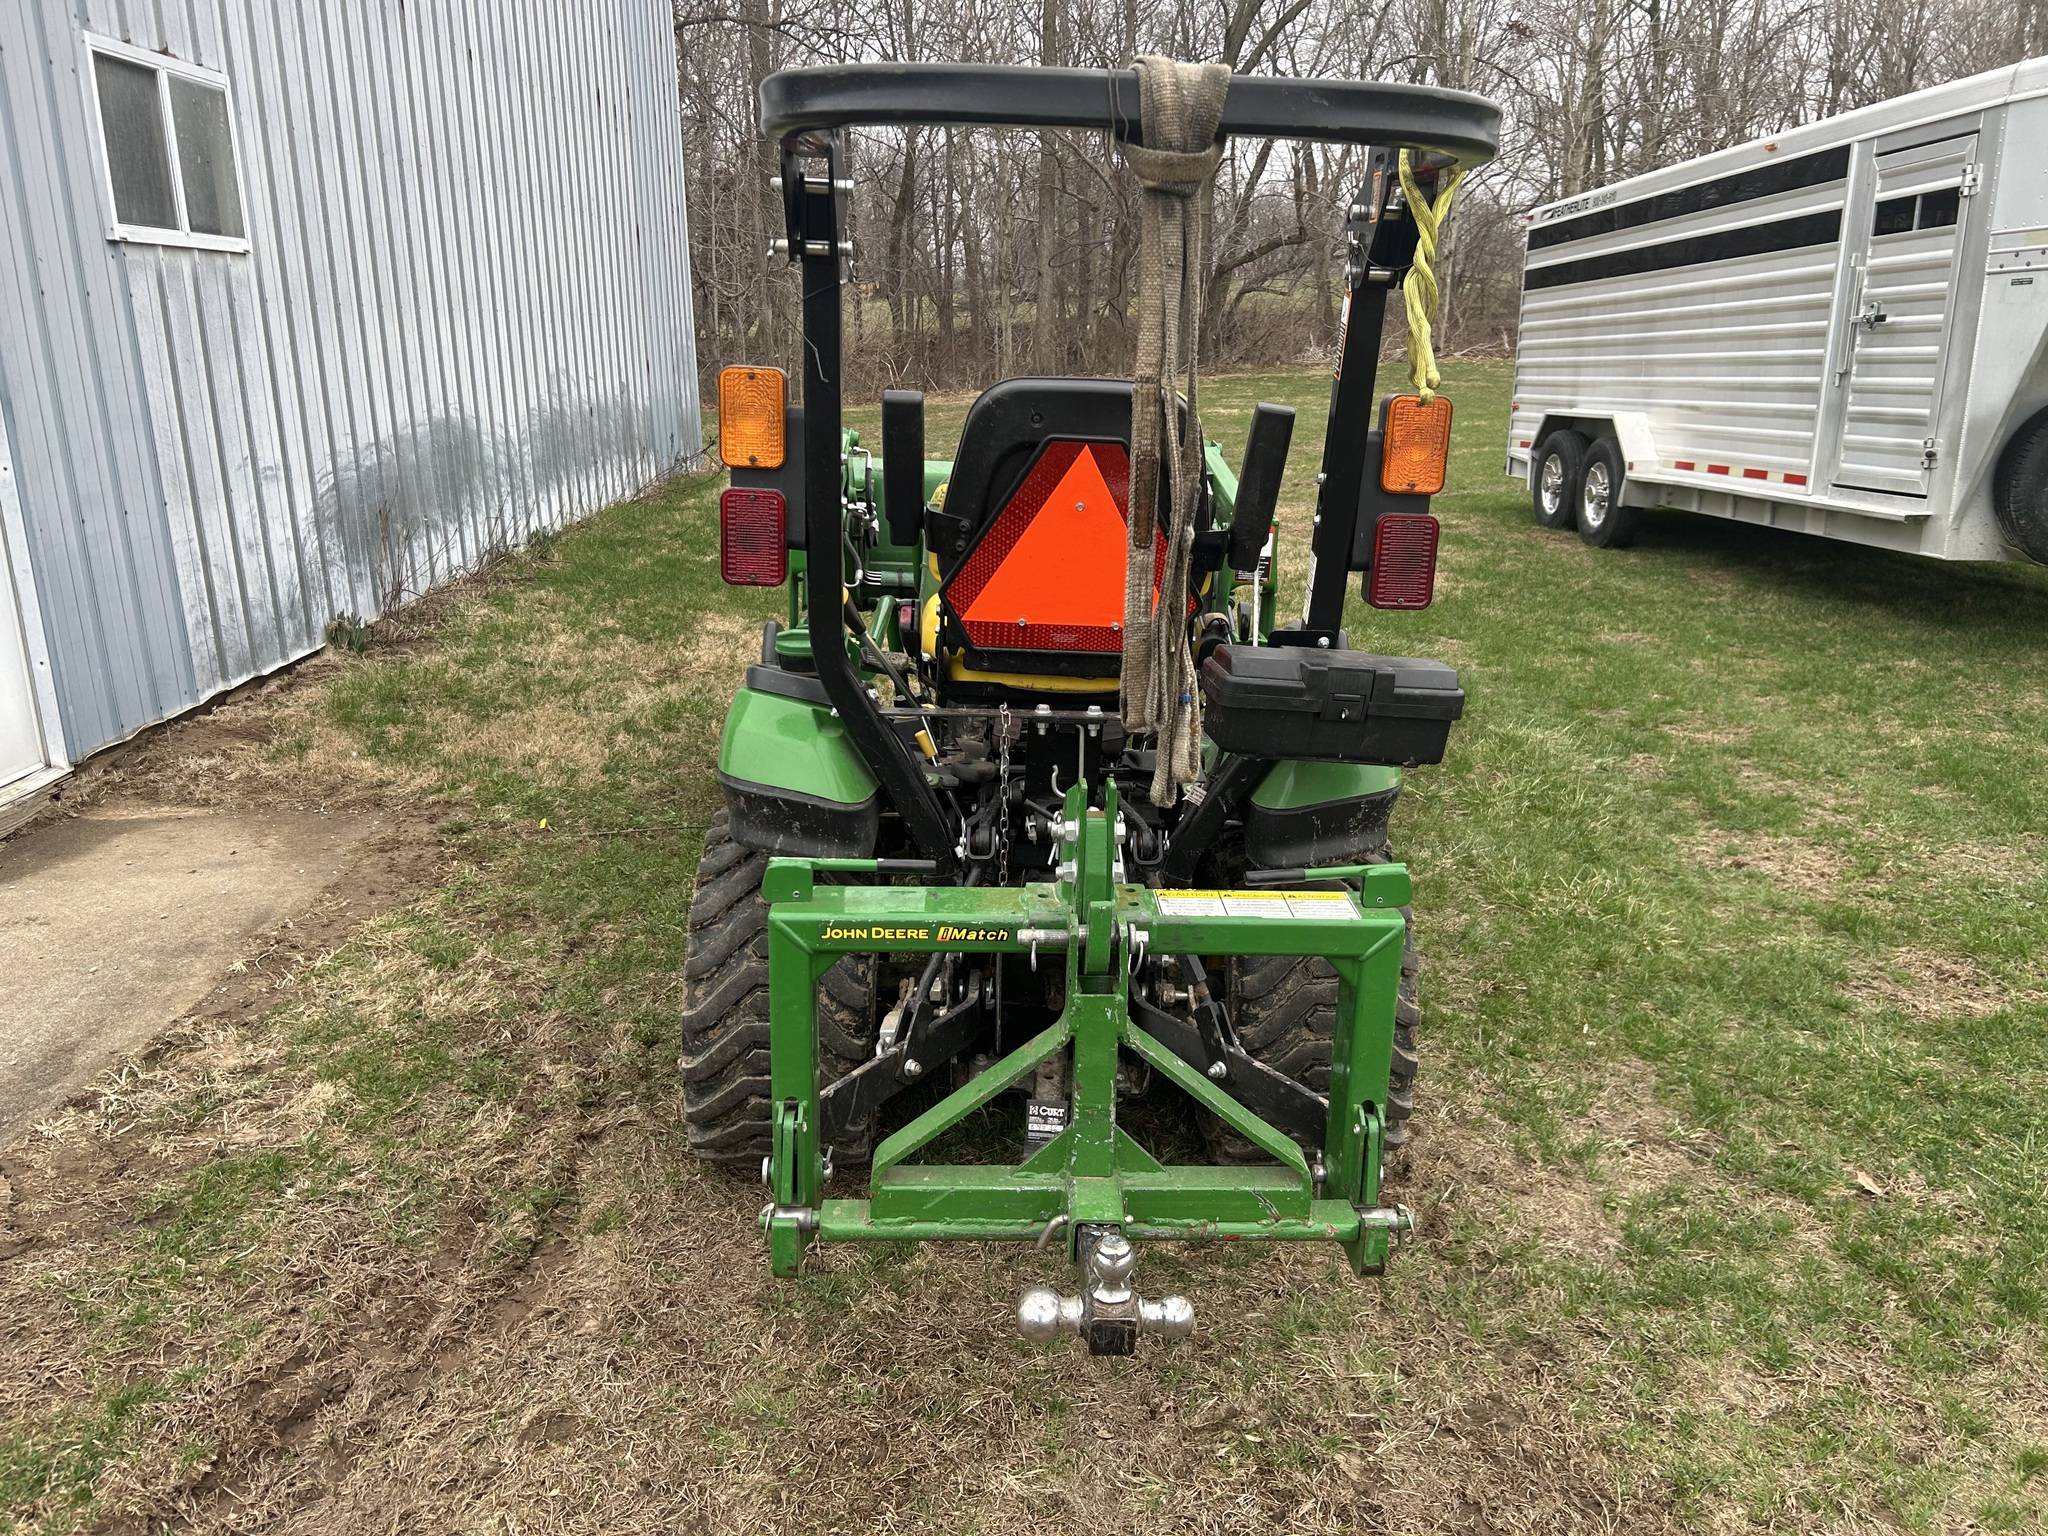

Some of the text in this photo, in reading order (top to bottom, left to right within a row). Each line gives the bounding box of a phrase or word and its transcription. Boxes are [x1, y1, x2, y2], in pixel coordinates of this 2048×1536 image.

[1552, 197, 1590, 218] FEATHERLITE
[821, 926, 868, 939] JOHN
[871, 926, 929, 940] DEERE
[1039, 1105, 1065, 1117] CURT
